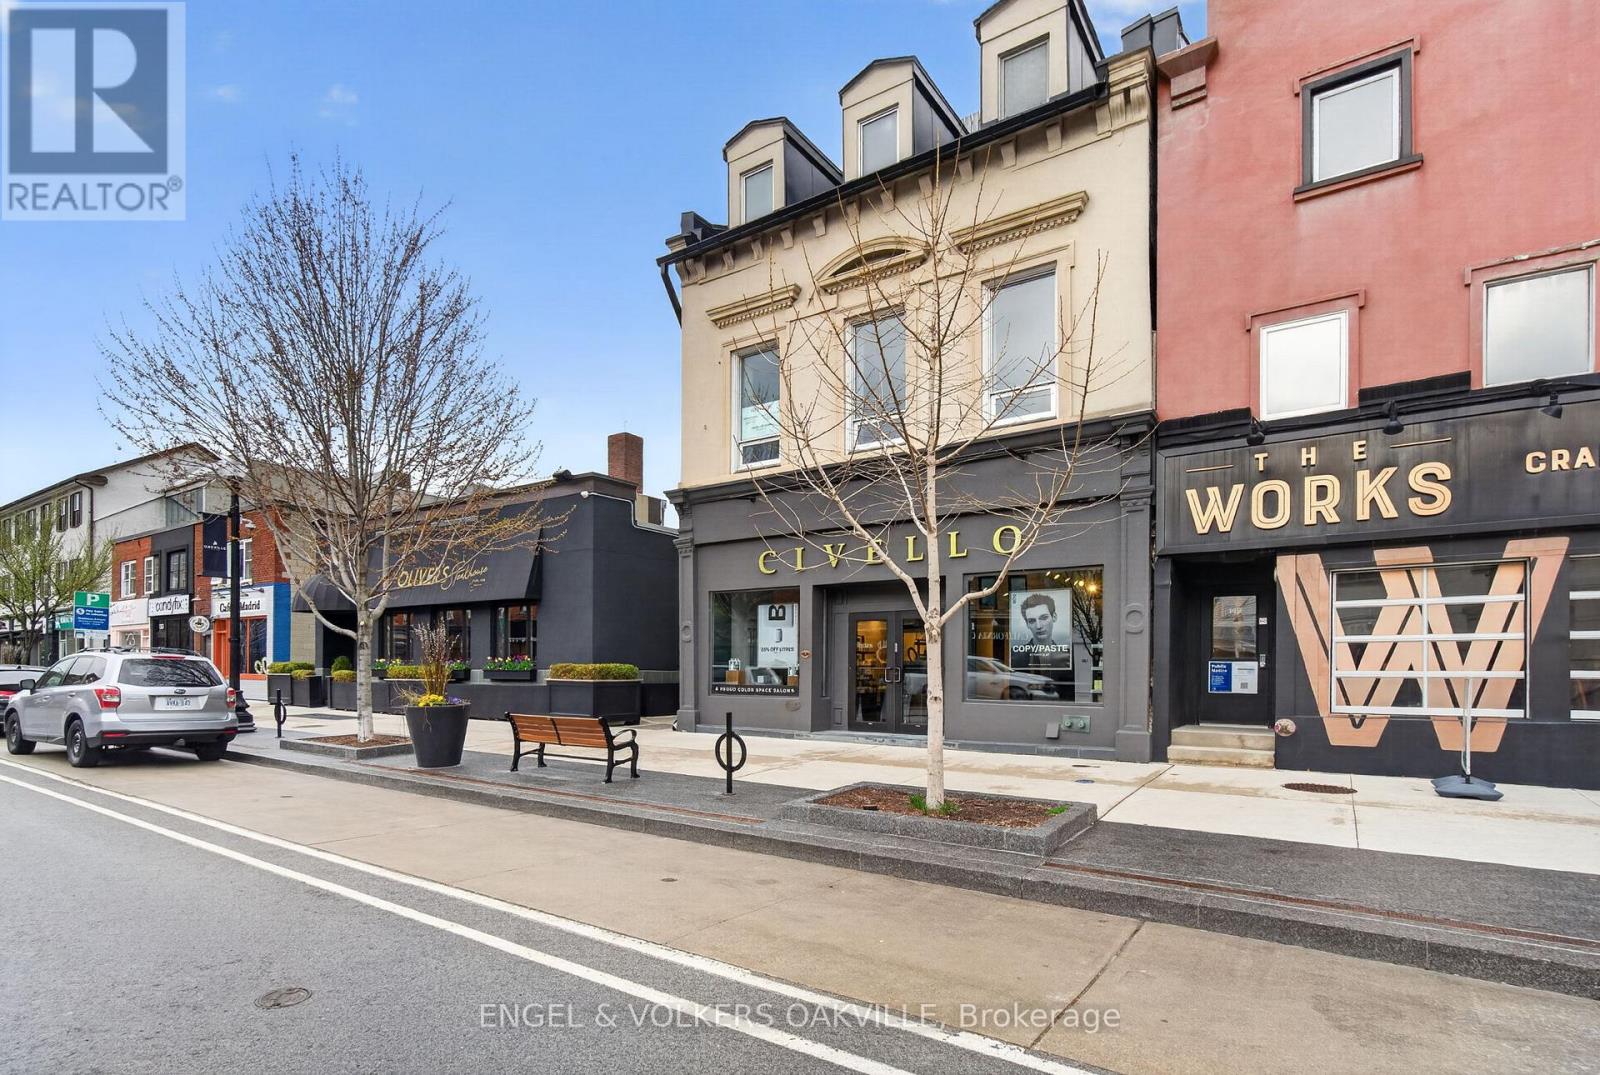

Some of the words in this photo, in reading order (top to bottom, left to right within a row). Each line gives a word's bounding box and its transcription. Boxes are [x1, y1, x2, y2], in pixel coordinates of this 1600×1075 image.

[1254, 439, 1367, 472] THE
[1525, 446, 1597, 474] CRA
[1185, 461, 1453, 535] WORKS
[758, 524, 1025, 576] CIVELLO
[86, 593, 100, 606] P
[1012, 644, 1069, 654] COPY/PASTE
